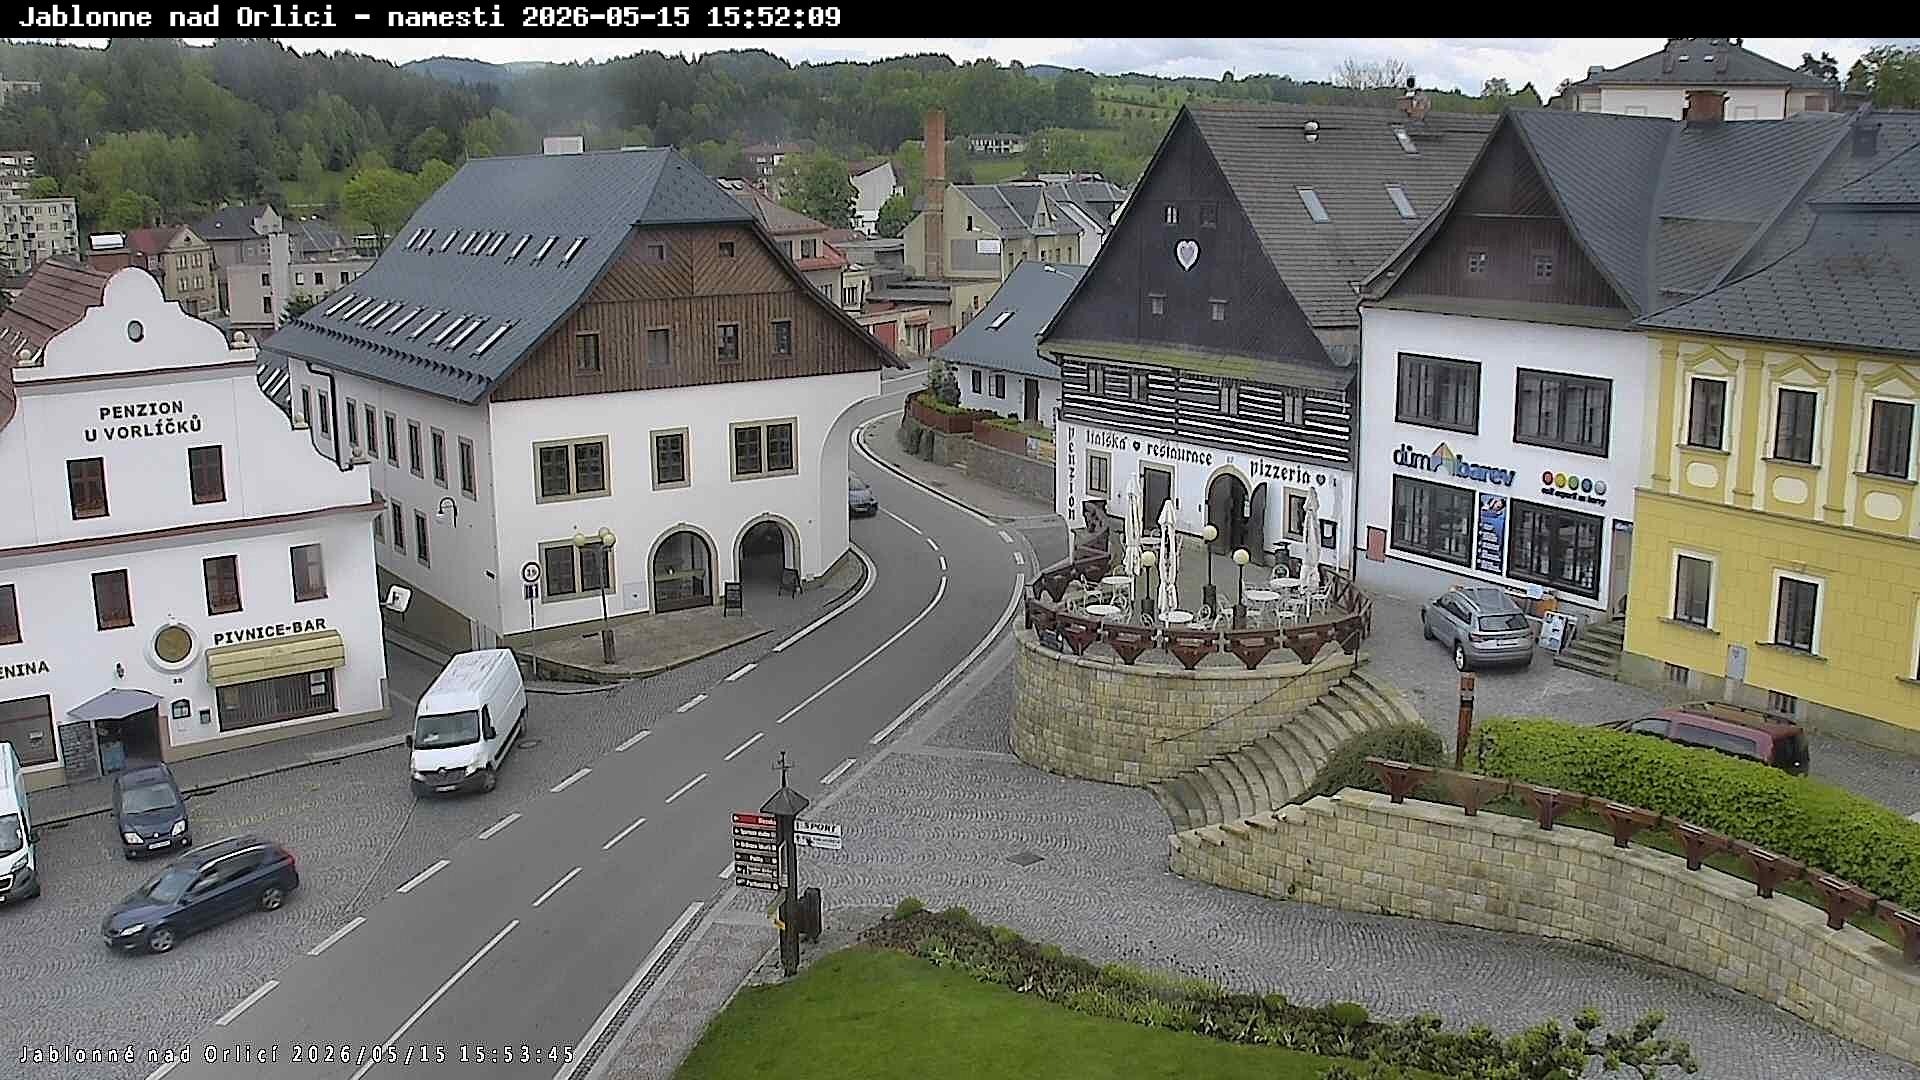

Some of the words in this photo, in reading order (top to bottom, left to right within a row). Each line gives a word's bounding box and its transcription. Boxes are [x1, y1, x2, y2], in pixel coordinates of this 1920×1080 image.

[100, 401, 182, 420] PENZION
[85, 429, 97, 442] U
[103, 414, 201, 440] VORLÍČKŮ
[1068, 426, 1076, 521] penzion
[1147, 441, 1213, 466] restaurace
[1250, 459, 1311, 484] pizzeria
[214, 618, 327, 645] PIVNICE-BAR
